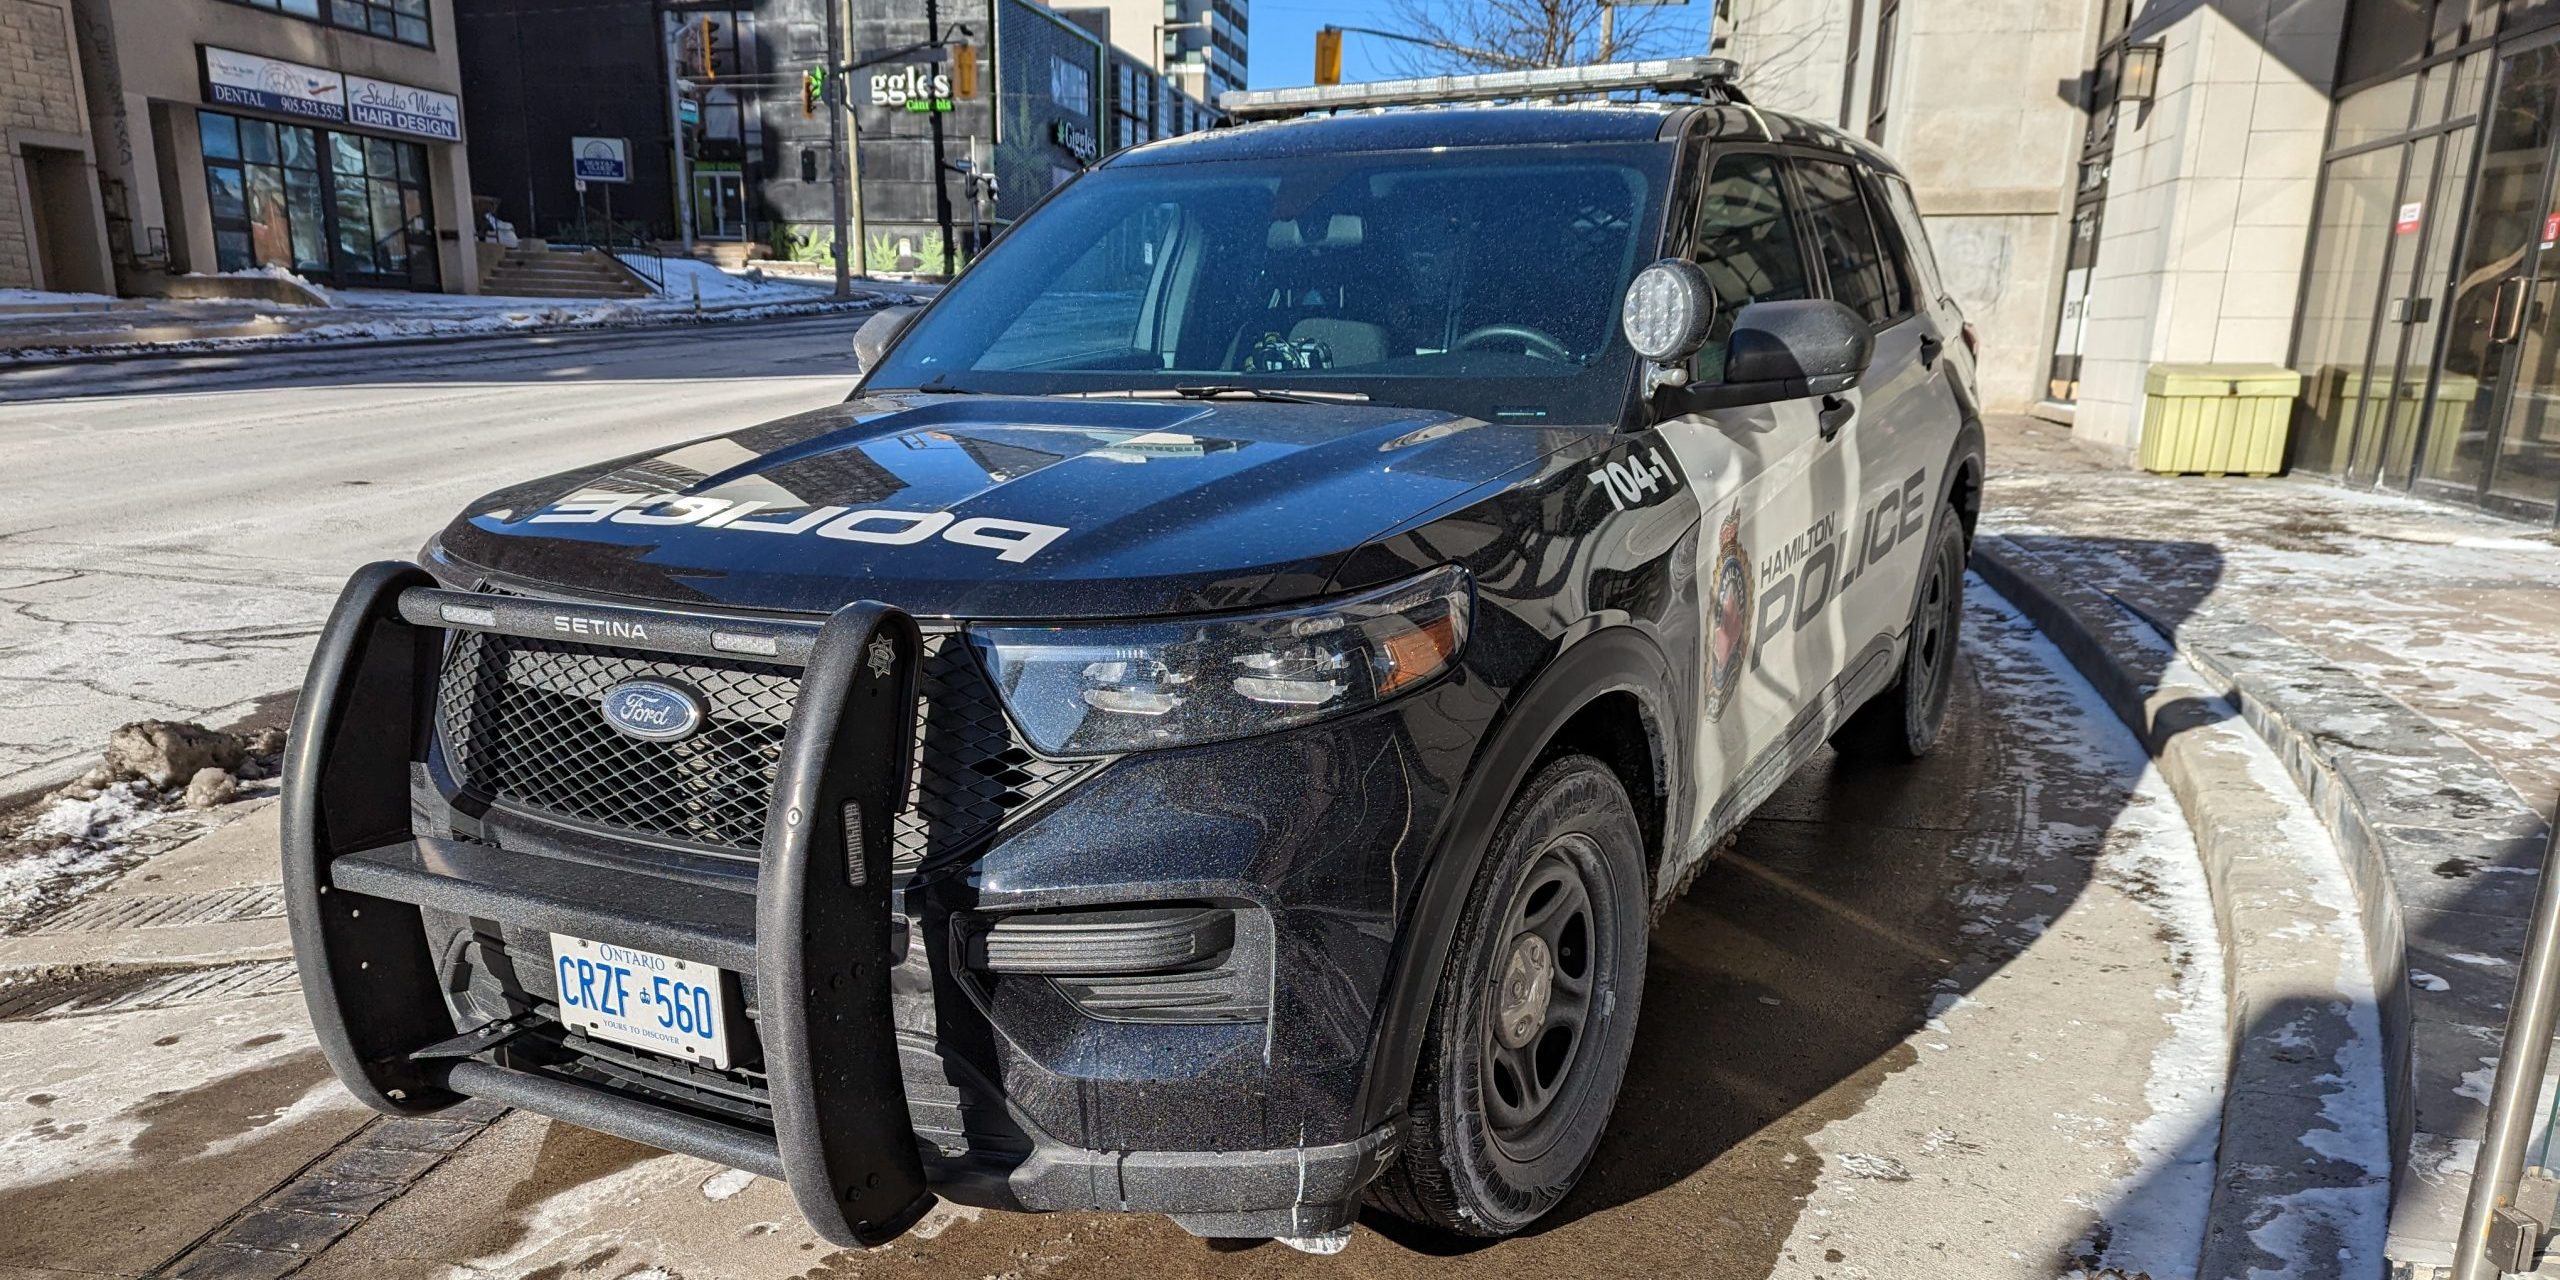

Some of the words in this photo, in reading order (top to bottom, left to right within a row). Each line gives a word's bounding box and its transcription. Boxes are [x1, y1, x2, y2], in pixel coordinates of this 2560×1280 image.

[215, 85, 266, 107] DENTAL
[281, 97, 343, 120] 905.523.5525
[361, 83, 406, 110] Studio
[408, 91, 442, 117] West
[356, 106, 393, 126] HAIR
[396, 114, 452, 136] DESIGN
[1065, 121, 1097, 160] Giggles
[1588, 447, 1678, 511] 704-1
[1760, 511, 1836, 589] HAMILTON
[1749, 466, 1926, 674] POLICE
[554, 616, 648, 640] SETINA
[620, 693, 671, 725] Ford
[600, 943, 665, 971] ONTARIO
[559, 955, 631, 1017] CRZF
[653, 976, 713, 1039] 560
[603, 1019, 628, 1033] YOURS
[630, 1025, 641, 1035] TO
[642, 1029, 680, 1045] DISCOVER
